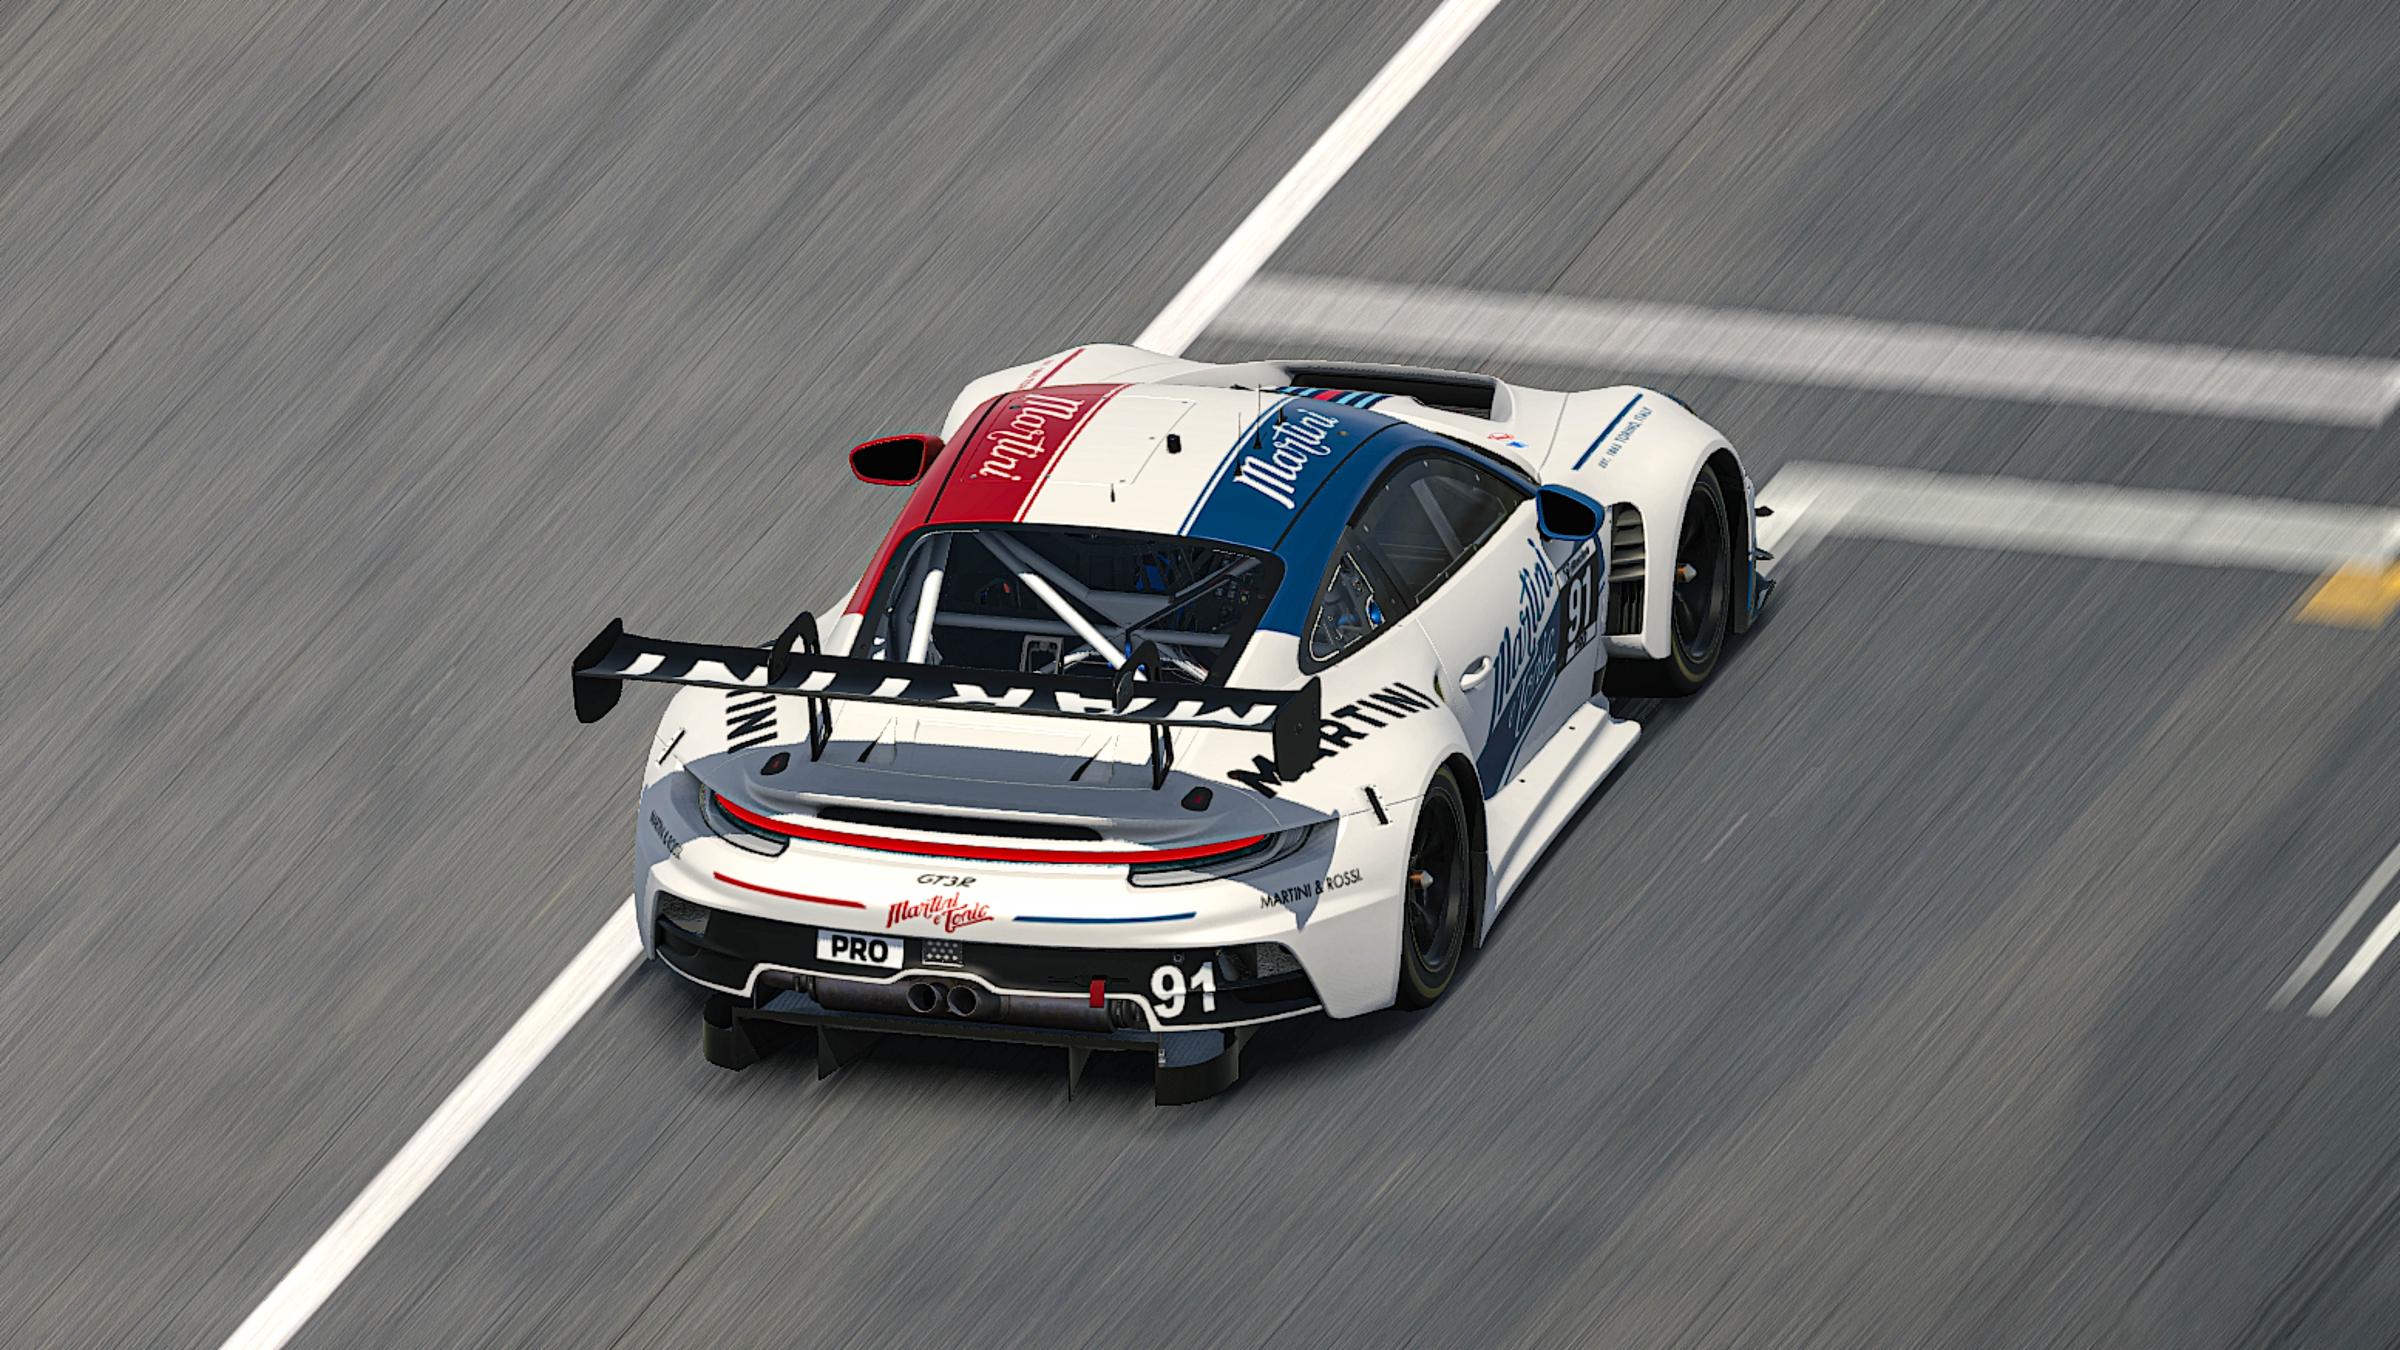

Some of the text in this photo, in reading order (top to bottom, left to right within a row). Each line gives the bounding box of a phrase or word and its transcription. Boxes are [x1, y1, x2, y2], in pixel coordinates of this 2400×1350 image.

[979, 394, 1085, 481] Martini
[1233, 408, 1339, 509] Martini
[1487, 538, 1553, 736] Martini
[1568, 564, 1592, 644] 91
[1227, 682, 1440, 799] MRTINI
[886, 892, 960, 928] Martini
[933, 902, 994, 933] e Tonic
[1261, 884, 1312, 909] MARTINI
[1315, 880, 1324, 895] &
[832, 935, 888, 963] PRO
[1150, 961, 1216, 1019] 91
